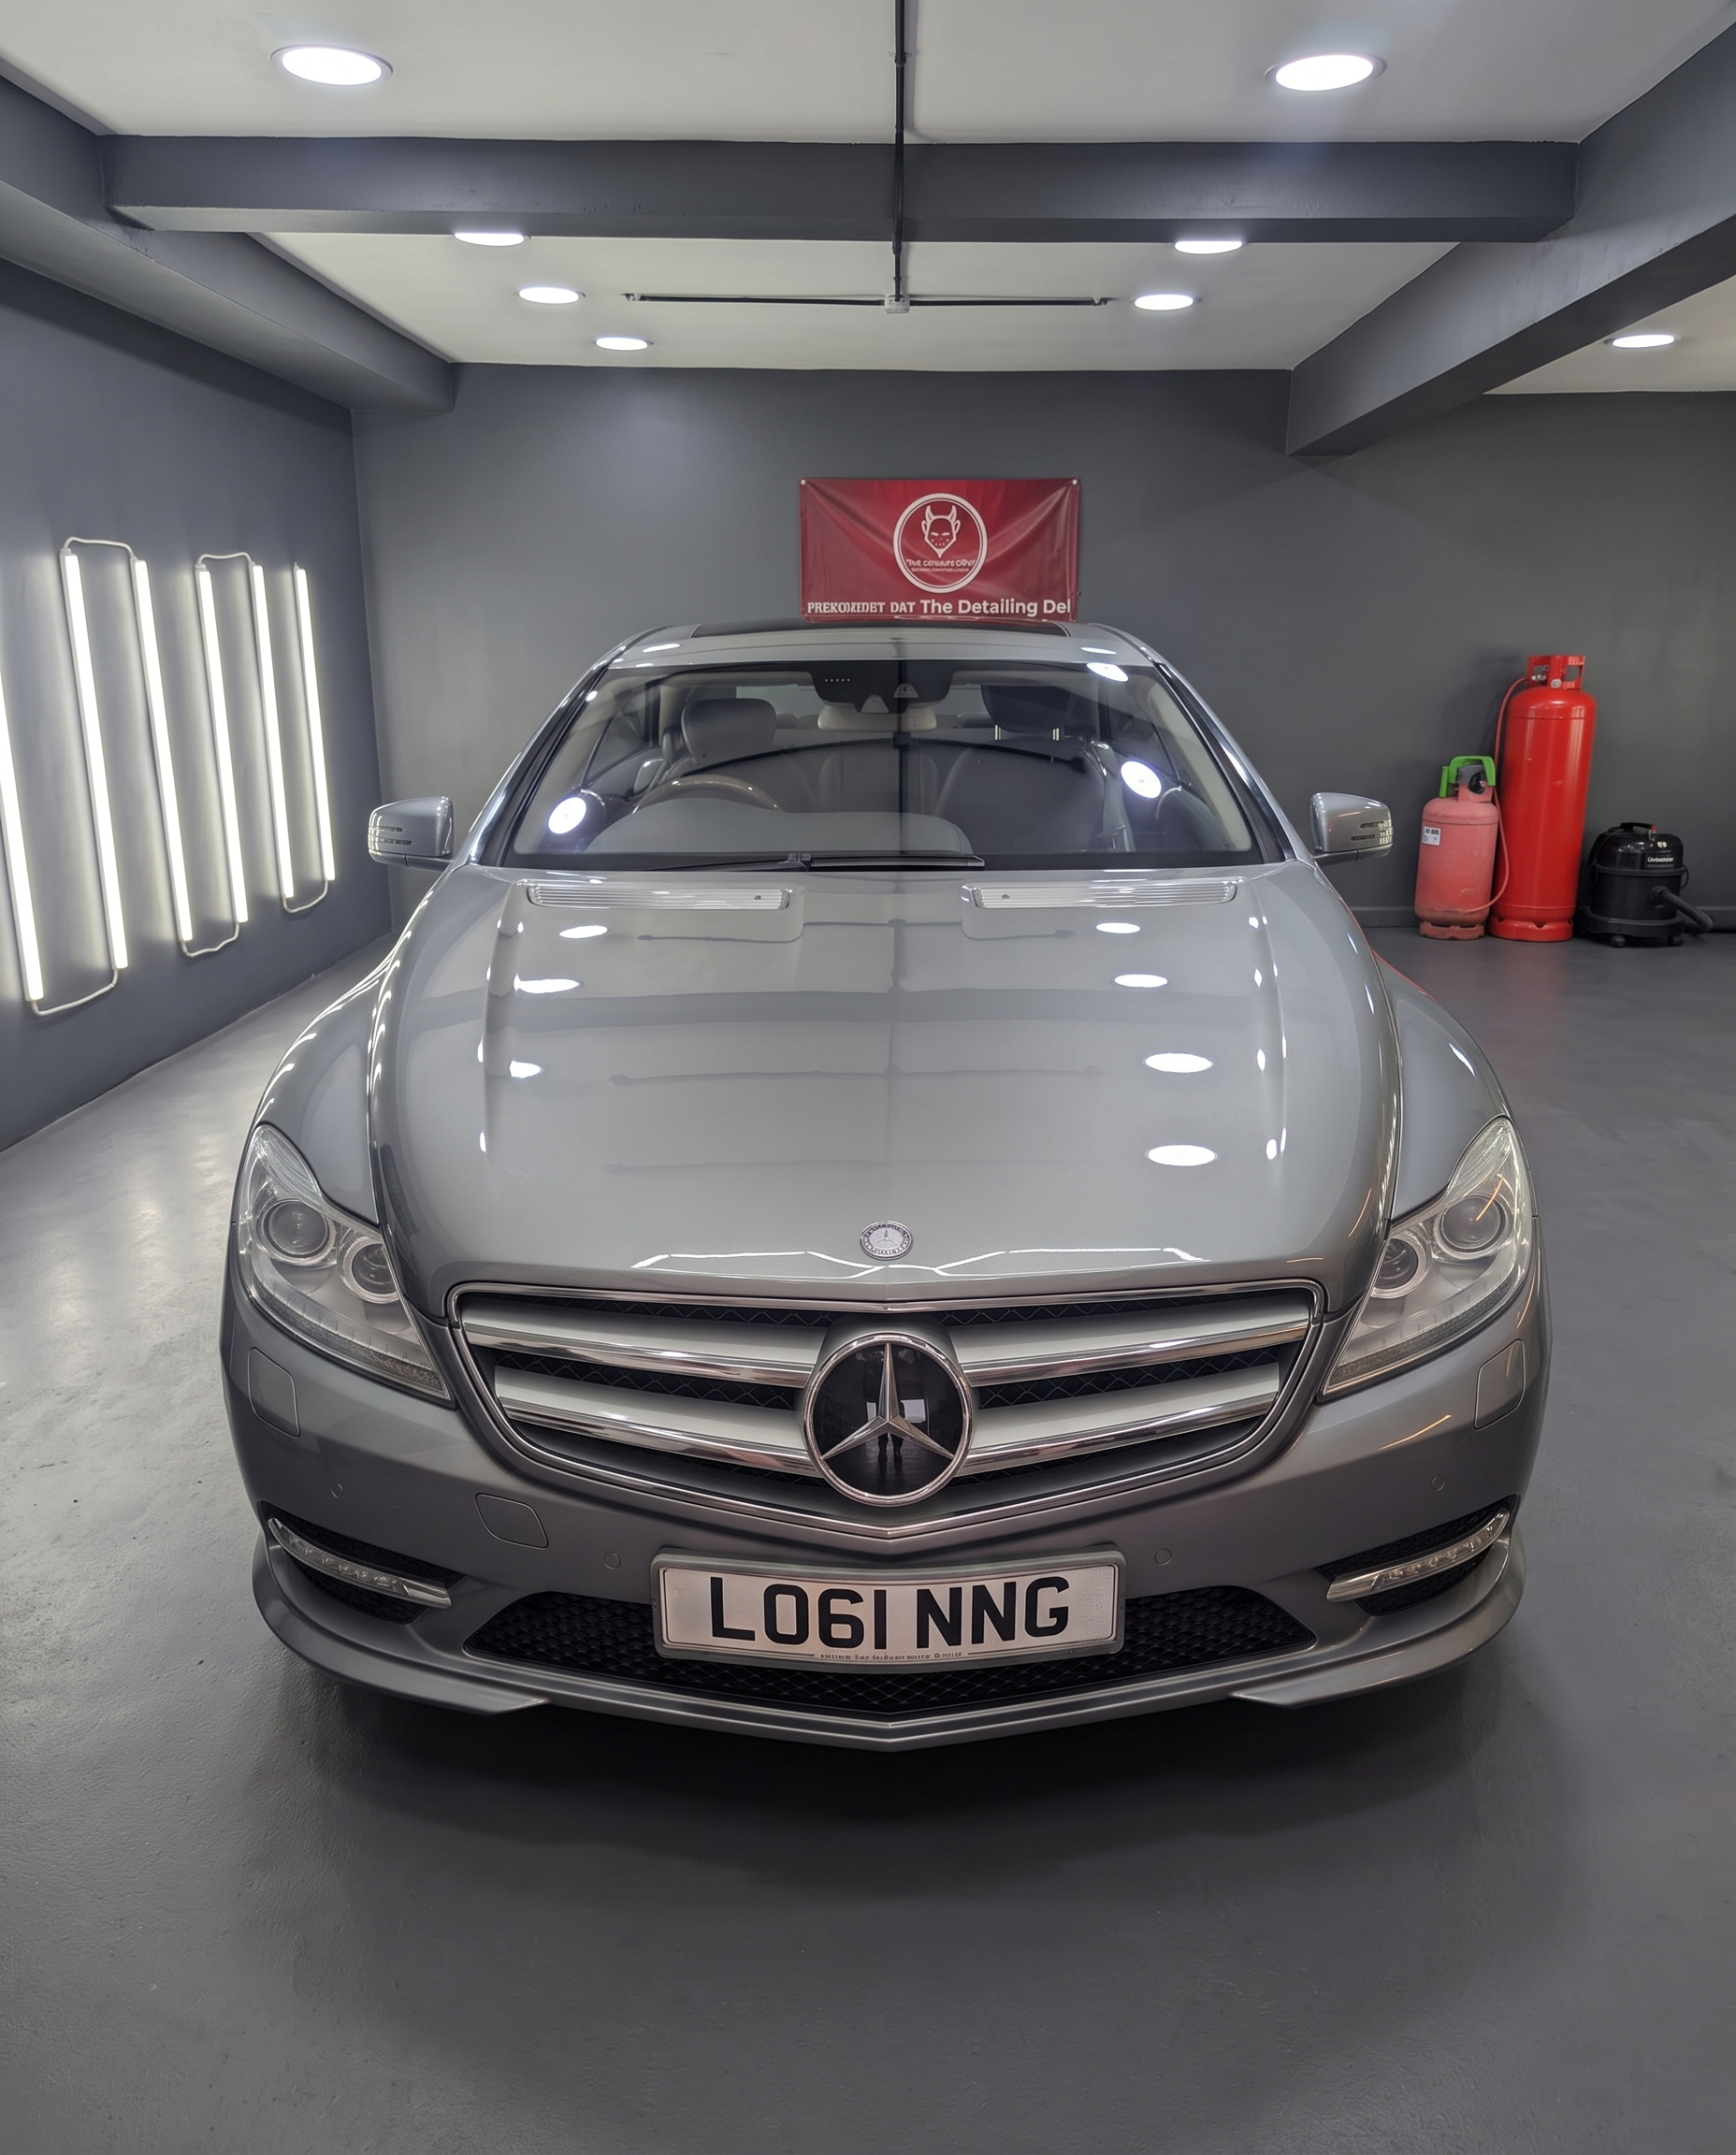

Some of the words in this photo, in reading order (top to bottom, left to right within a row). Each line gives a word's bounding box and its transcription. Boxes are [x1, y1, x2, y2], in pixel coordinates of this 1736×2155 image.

[919, 599, 953, 614] The
[958, 598, 1038, 617] Detailing
[1043, 598, 1071, 614] Del
[916, 1575, 1070, 1650] NNG
